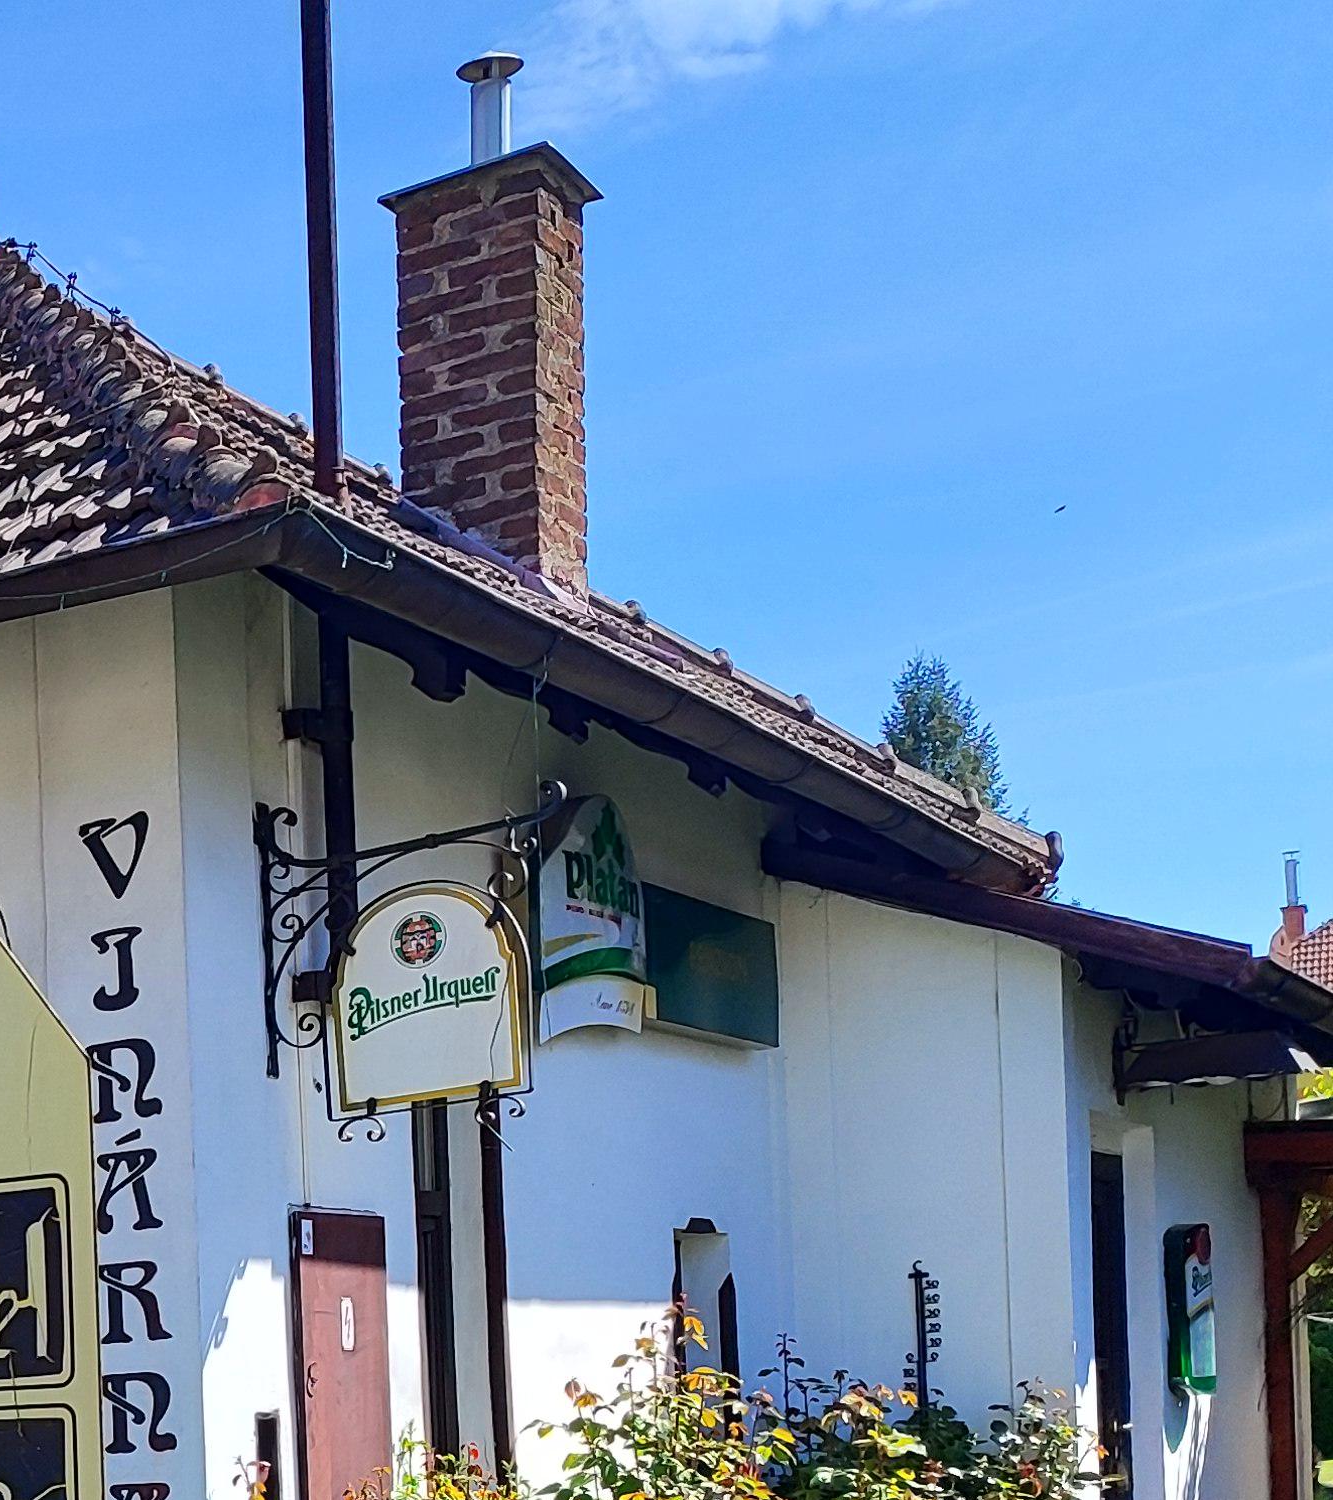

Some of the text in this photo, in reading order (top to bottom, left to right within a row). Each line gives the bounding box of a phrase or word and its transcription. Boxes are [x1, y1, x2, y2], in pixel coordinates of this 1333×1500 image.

[562, 850, 641, 920] Platan
[347, 966, 501, 1041] Pilsner Urquell
